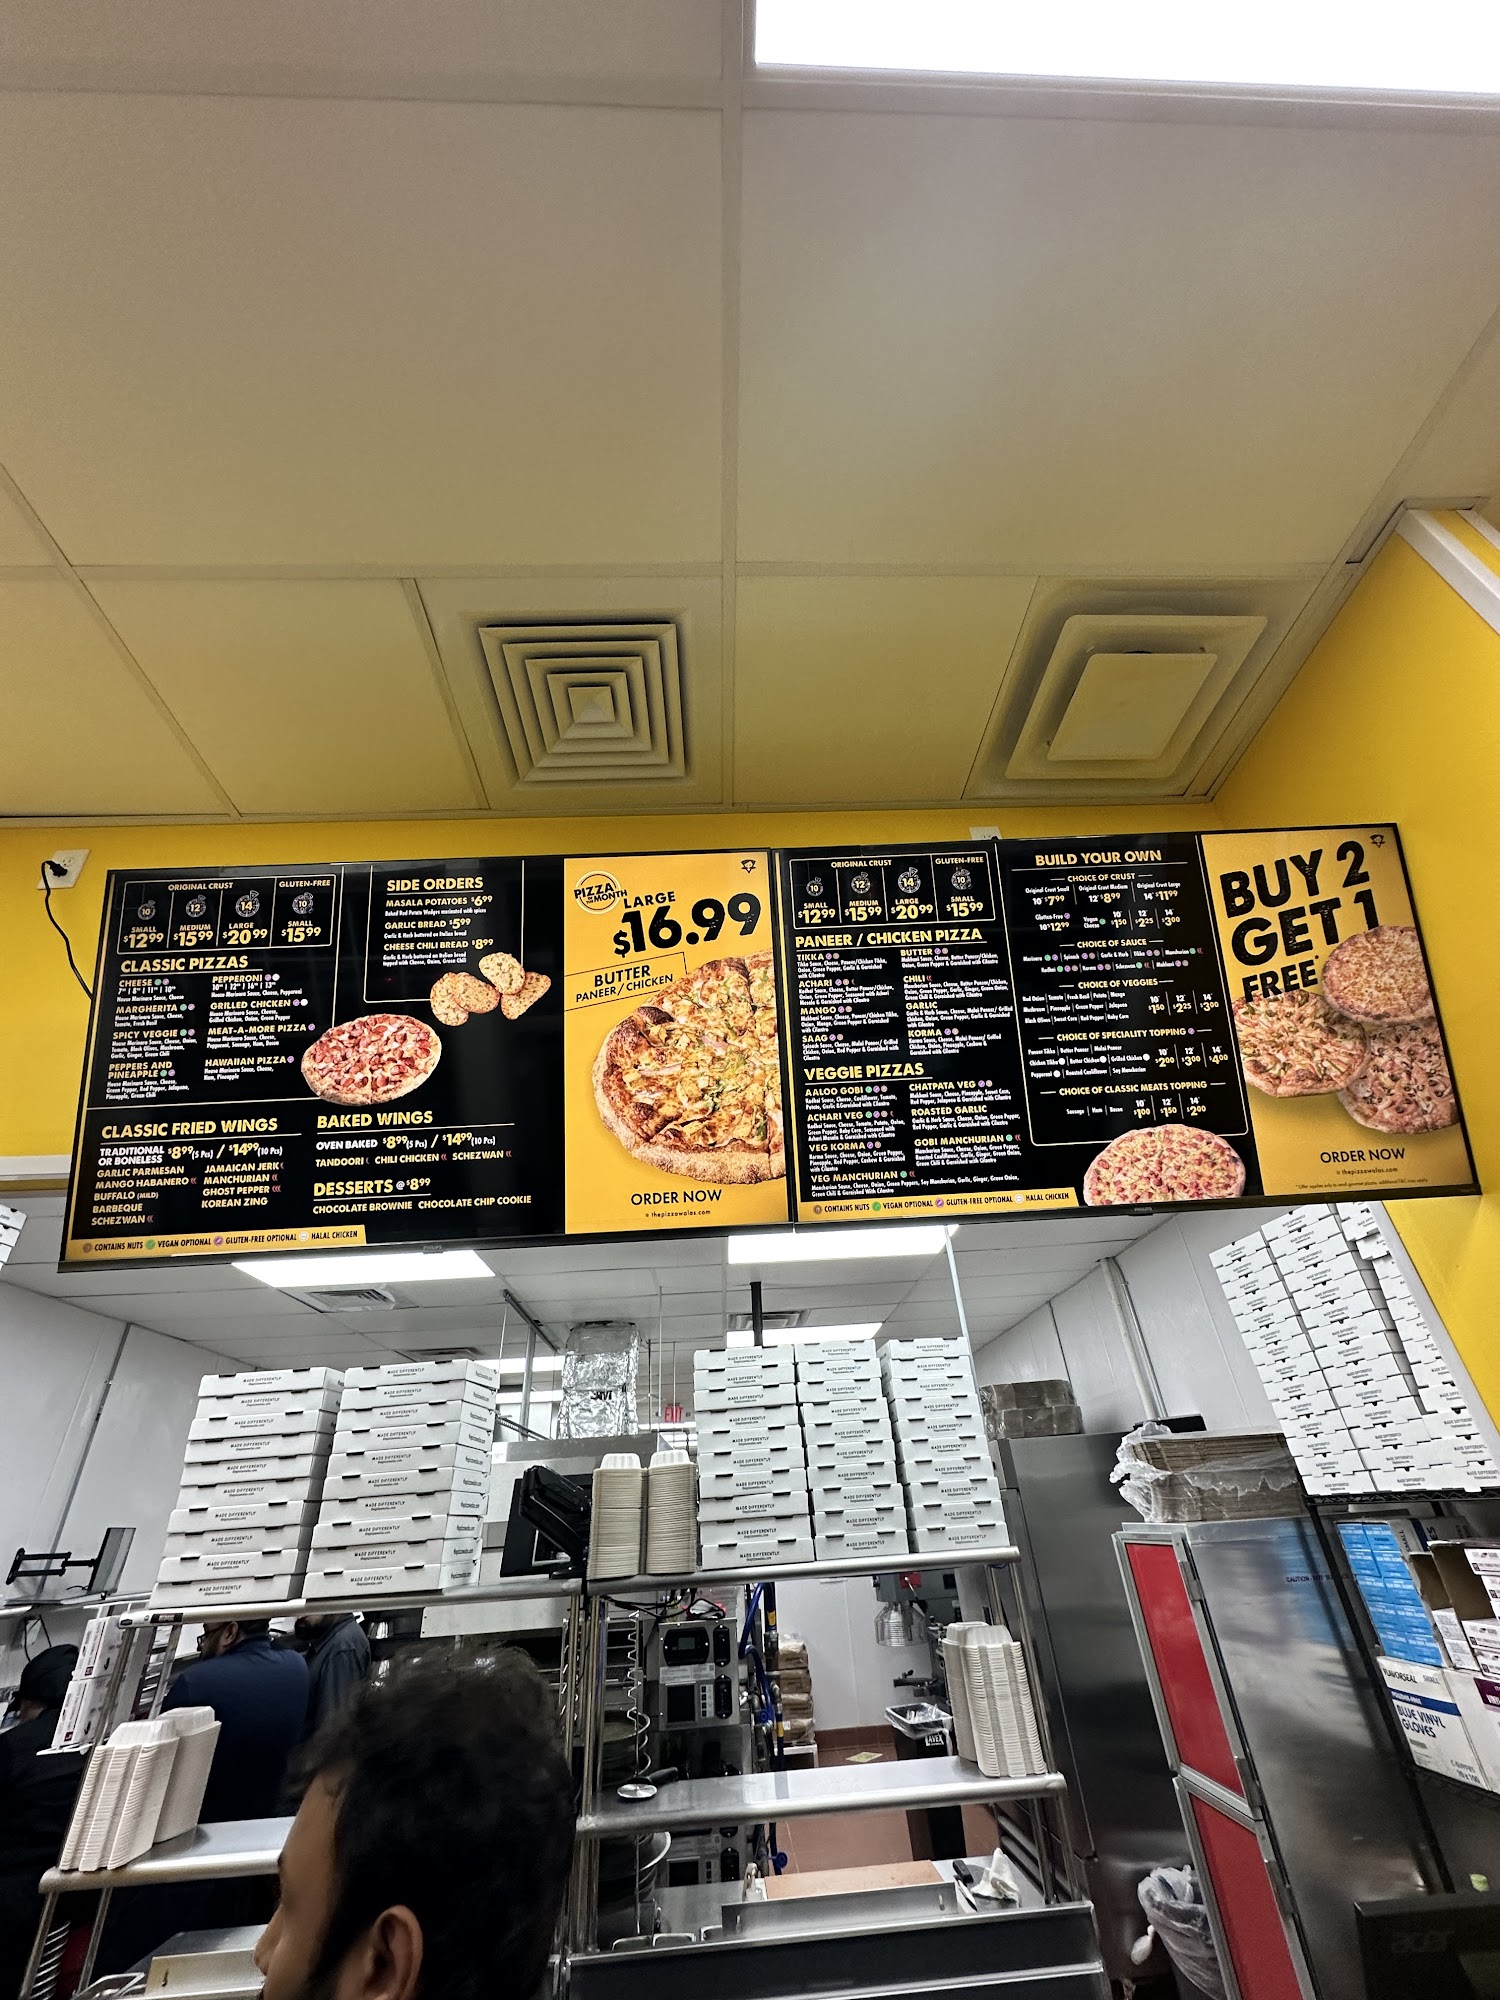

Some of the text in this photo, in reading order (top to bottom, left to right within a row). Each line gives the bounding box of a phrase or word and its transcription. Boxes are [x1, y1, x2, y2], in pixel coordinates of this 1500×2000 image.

[1035, 850, 1161, 866] BUILD YOUR OWN
[168, 883, 207, 891] ORIGINAL
[387, 876, 484, 892] SIDE ORDERS
[1220, 841, 1370, 923] BUY 2
[574, 883, 614, 899] PIZZA
[594, 889, 628, 902] MONTH
[386, 899, 423, 907] MASALA
[425, 897, 467, 905] POTATOES
[623, 891, 676, 909] LARGE
[385, 921, 416, 929] GARLIC
[418, 920, 446, 928] BREAD
[612, 892, 762, 958] $16.99
[1230, 889, 1382, 967] GET 1
[795, 934, 853, 948] PANEER
[867, 930, 932, 944] CHICKEN
[935, 928, 983, 943] PIZZA
[384, 943, 414, 951] CHEESE
[900, 948, 932, 956] BUTTER
[796, 953, 824, 961] TIKKA
[121, 956, 248, 973] CLASSIC PIZZAS
[212, 974, 263, 984] PEPPERONI
[594, 965, 651, 987] BUTTER
[903, 975, 925, 983] CHILI
[119, 979, 152, 987] CHEESE
[626, 973, 674, 993] CHICKEN
[799, 979, 832, 988] ACHARI
[1078, 981, 1108, 989] CHOICE
[1122, 978, 1158, 987] VEGGIES
[116, 1004, 177, 1014] MARGHERITA
[210, 999, 291, 1010] GRILLED CHICKEN
[906, 1001, 937, 1010] GARLIC
[800, 1006, 836, 1015] MANGO
[113, 1029, 178, 1039] SPICY VEGGIE
[208, 1024, 306, 1035] MEAT-A-MORE PIZZA
[908, 1029, 942, 1037] KORMA
[1057, 1033, 1087, 1041] CHOICE
[1102, 1030, 1147, 1039] SPECIALITY
[1149, 1028, 1186, 1036] TOPPING
[802, 1034, 828, 1043] SAAG
[109, 1061, 172, 1073] PEPPERS AND
[804, 1063, 924, 1080] VEGGIE PIZZAS
[108, 1068, 158, 1079] PINEAPPLE
[805, 1086, 863, 1096] AALOO GOBI
[909, 1082, 955, 1091] CHATPATA
[1059, 1081, 1207, 1096] CHOICE OF CLASSIC MEATS TOPPING
[807, 1111, 863, 1121] ACHARI VEG
[911, 1105, 987, 1116] ROASTED GARLIC
[317, 1111, 433, 1128] BAKED WINGS
[102, 1118, 277, 1139] CLASSIC FRIED WINGS
[316, 1139, 378, 1150] OVEN BAKED
[809, 1142, 865, 1152] VEG KORMA
[100, 1146, 165, 1157] TRADITIONAL
[1320, 1148, 1405, 1163] ORDER NOW
[98, 1155, 162, 1166] OR BONELESS
[97, 1166, 184, 1177] GARLIC PARMESAN
[204, 1162, 279, 1173] JAMAICAN JERK
[96, 1177, 189, 1189] MANGO HABANERO
[204, 1174, 270, 1185] MANCHURIAN
[203, 1186, 270, 1196] GHOST PEPPER
[314, 1179, 393, 1196] DESSERTS
[94, 1191, 159, 1201] BUFFALO (MILD)
[631, 1189, 722, 1205] ORDER NOW
[202, 1197, 268, 1208] KOREAN ZING
[313, 1201, 412, 1214] CHOCOLATE BROWNIE
[418, 1195, 531, 1209] CHOCOLATE CHIP COOKIE
[93, 1203, 143, 1213] BARBEQUE
[92, 1215, 145, 1225] SCHEZWAN
[181, 1238, 211, 1246] OPTIONAL
[226, 1234, 296, 1244] GLUTEN-FREE OPTIONAL
[311, 1232, 329, 1241] HALAL
[94, 1241, 143, 1251] CONTAINS NUTS
[665, 1407, 683, 1423] EXIT
[754, 1550, 780, 1558] DIFFERENTLY
[1397, 1705, 1446, 1729] BLUE VINYL
[1401, 1717, 1437, 1739] GLOVES
